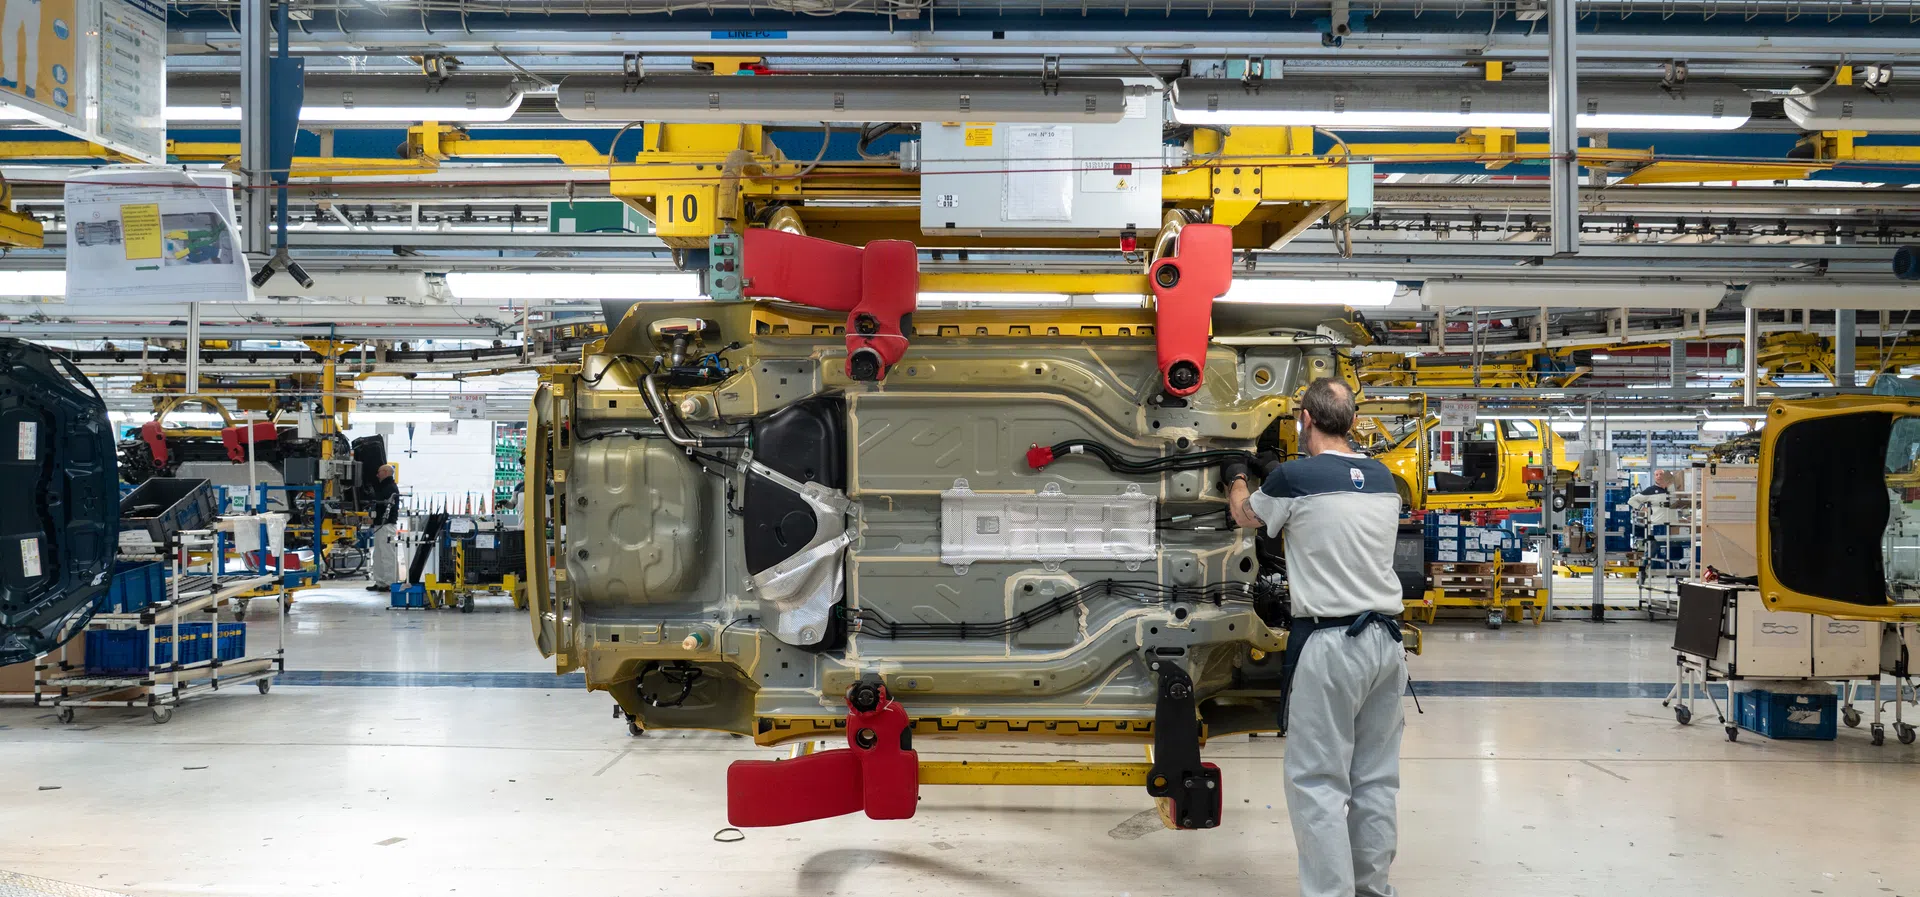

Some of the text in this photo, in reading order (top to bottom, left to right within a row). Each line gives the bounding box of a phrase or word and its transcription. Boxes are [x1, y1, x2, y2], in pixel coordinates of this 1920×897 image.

[666, 193, 698, 223] 10
[1761, 622, 1798, 634] 500
[1827, 622, 1860, 634] 500
